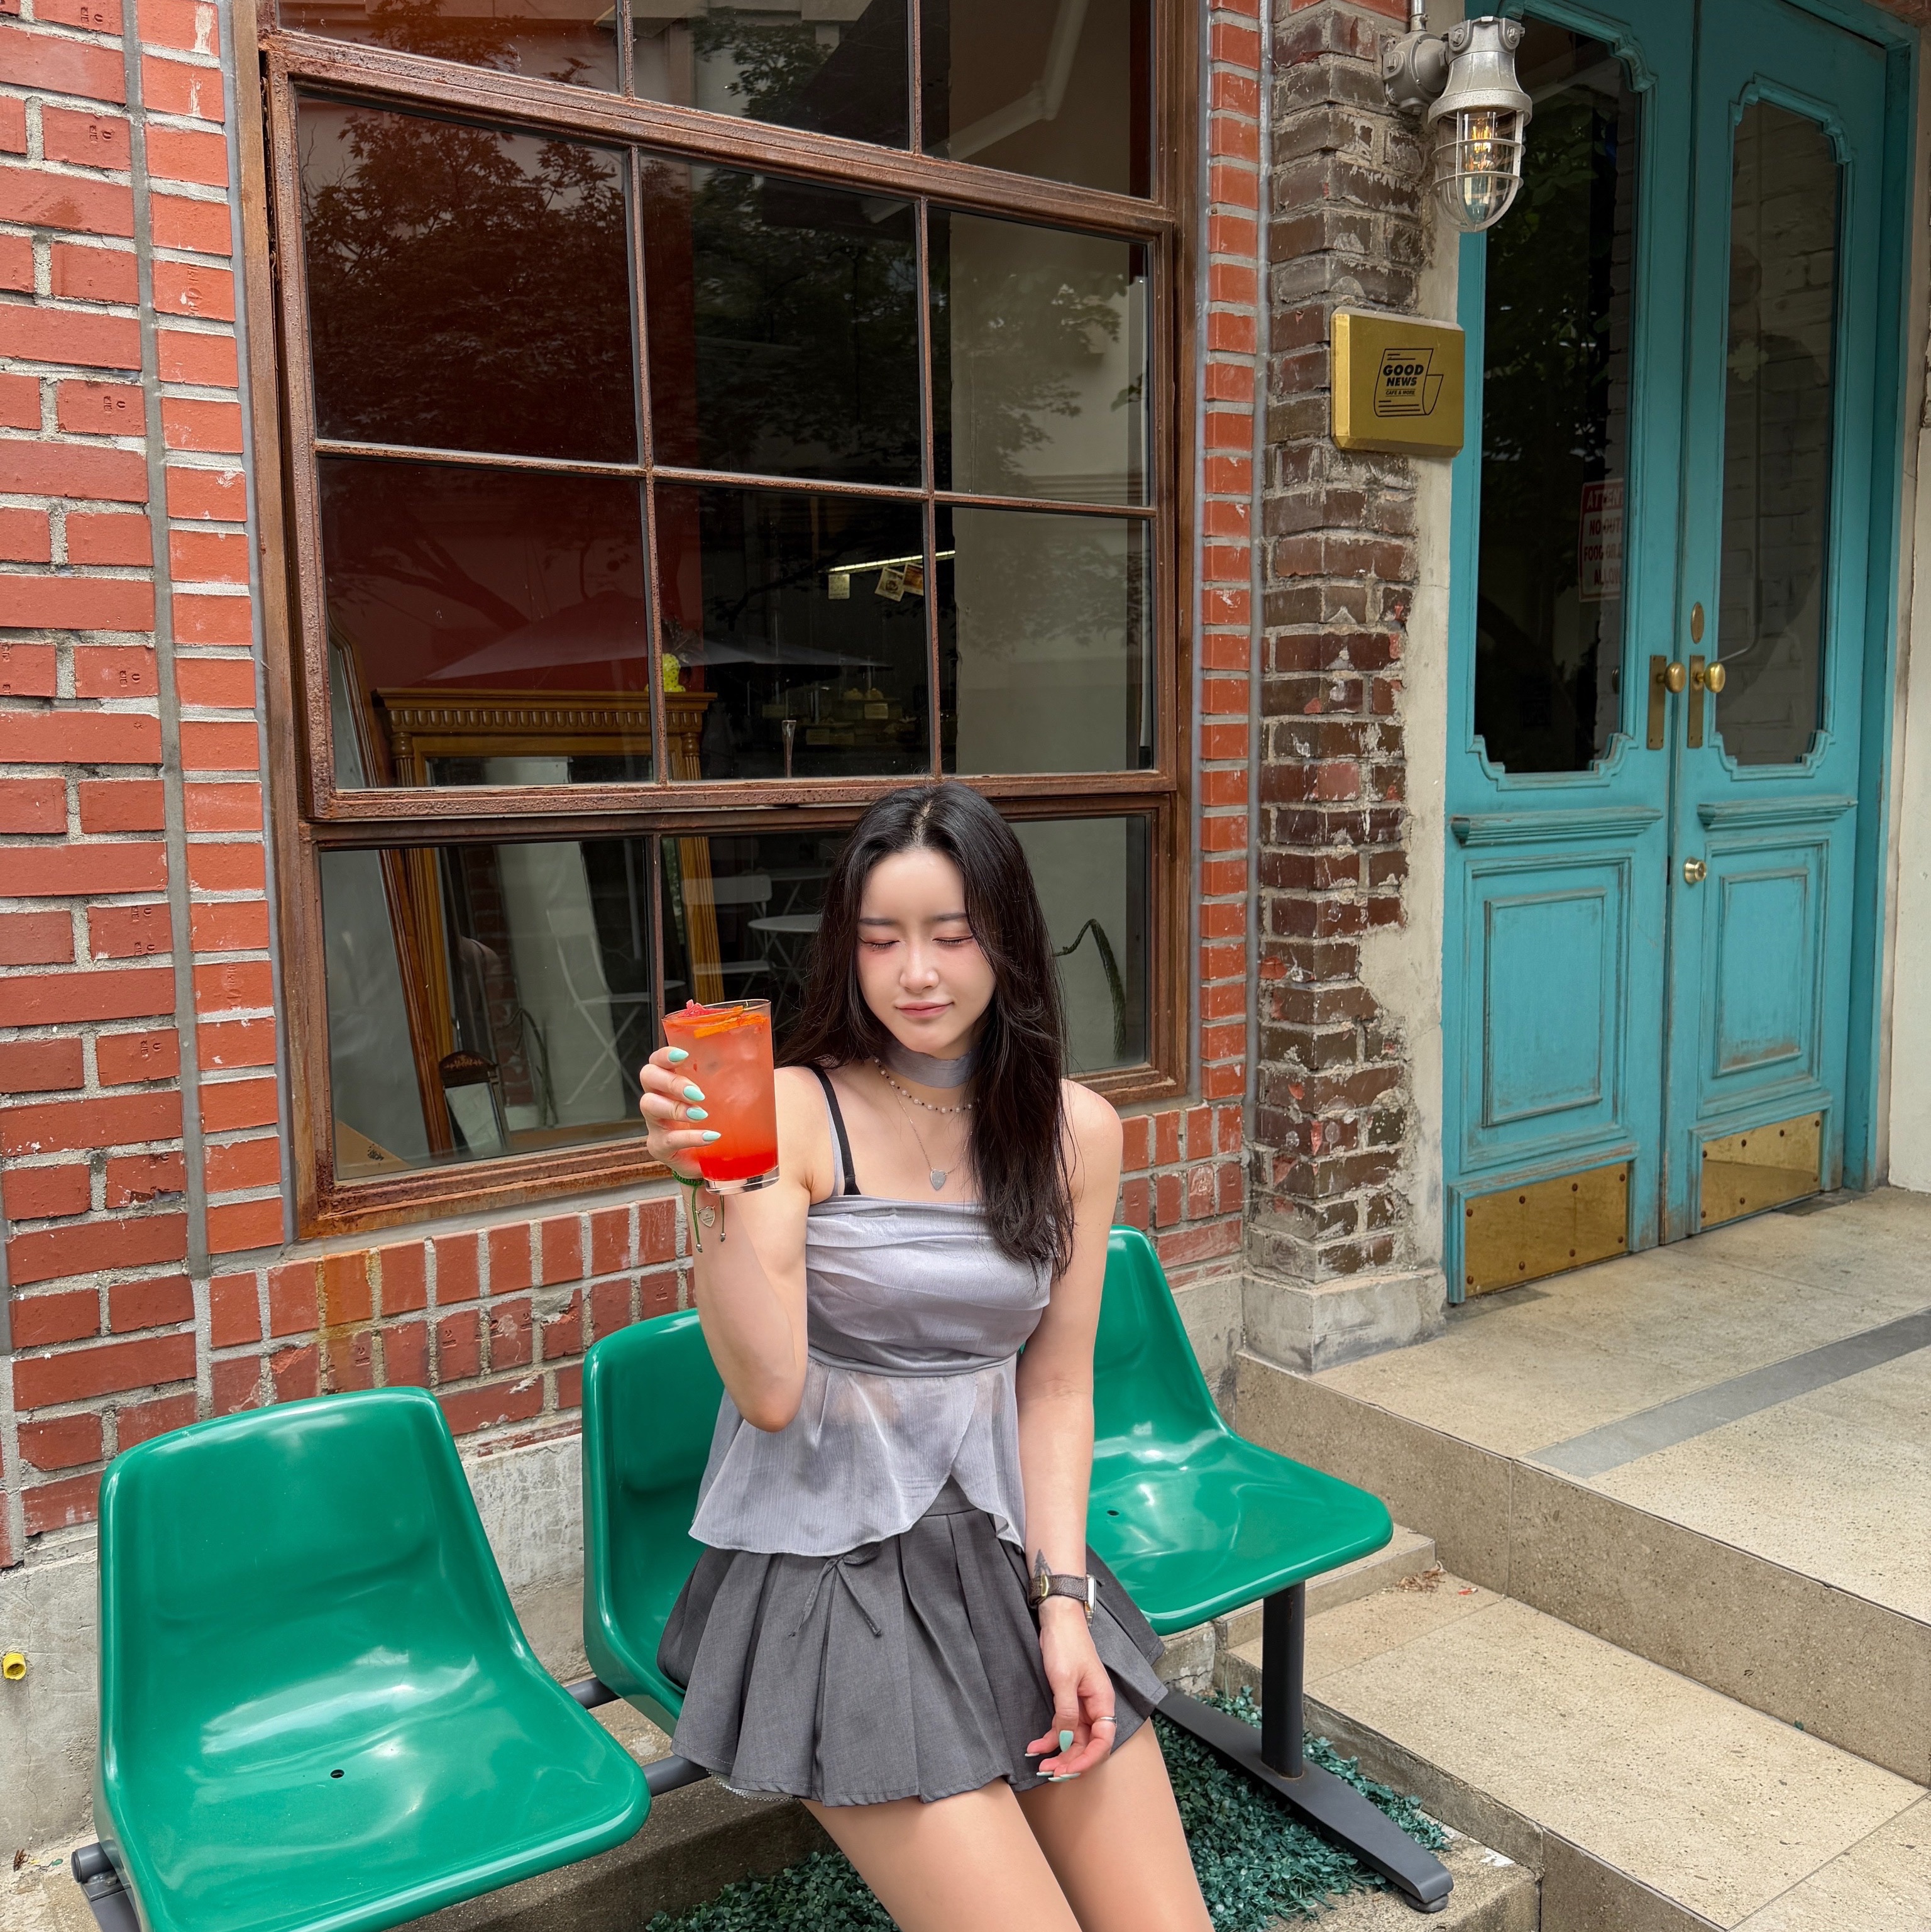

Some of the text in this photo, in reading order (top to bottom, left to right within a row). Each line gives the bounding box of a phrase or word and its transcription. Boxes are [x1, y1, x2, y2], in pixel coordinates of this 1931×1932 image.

[1383, 364, 1424, 376] GOOD
[1386, 377, 1417, 387] NEWS
[1588, 517, 1622, 536] NO OUT
